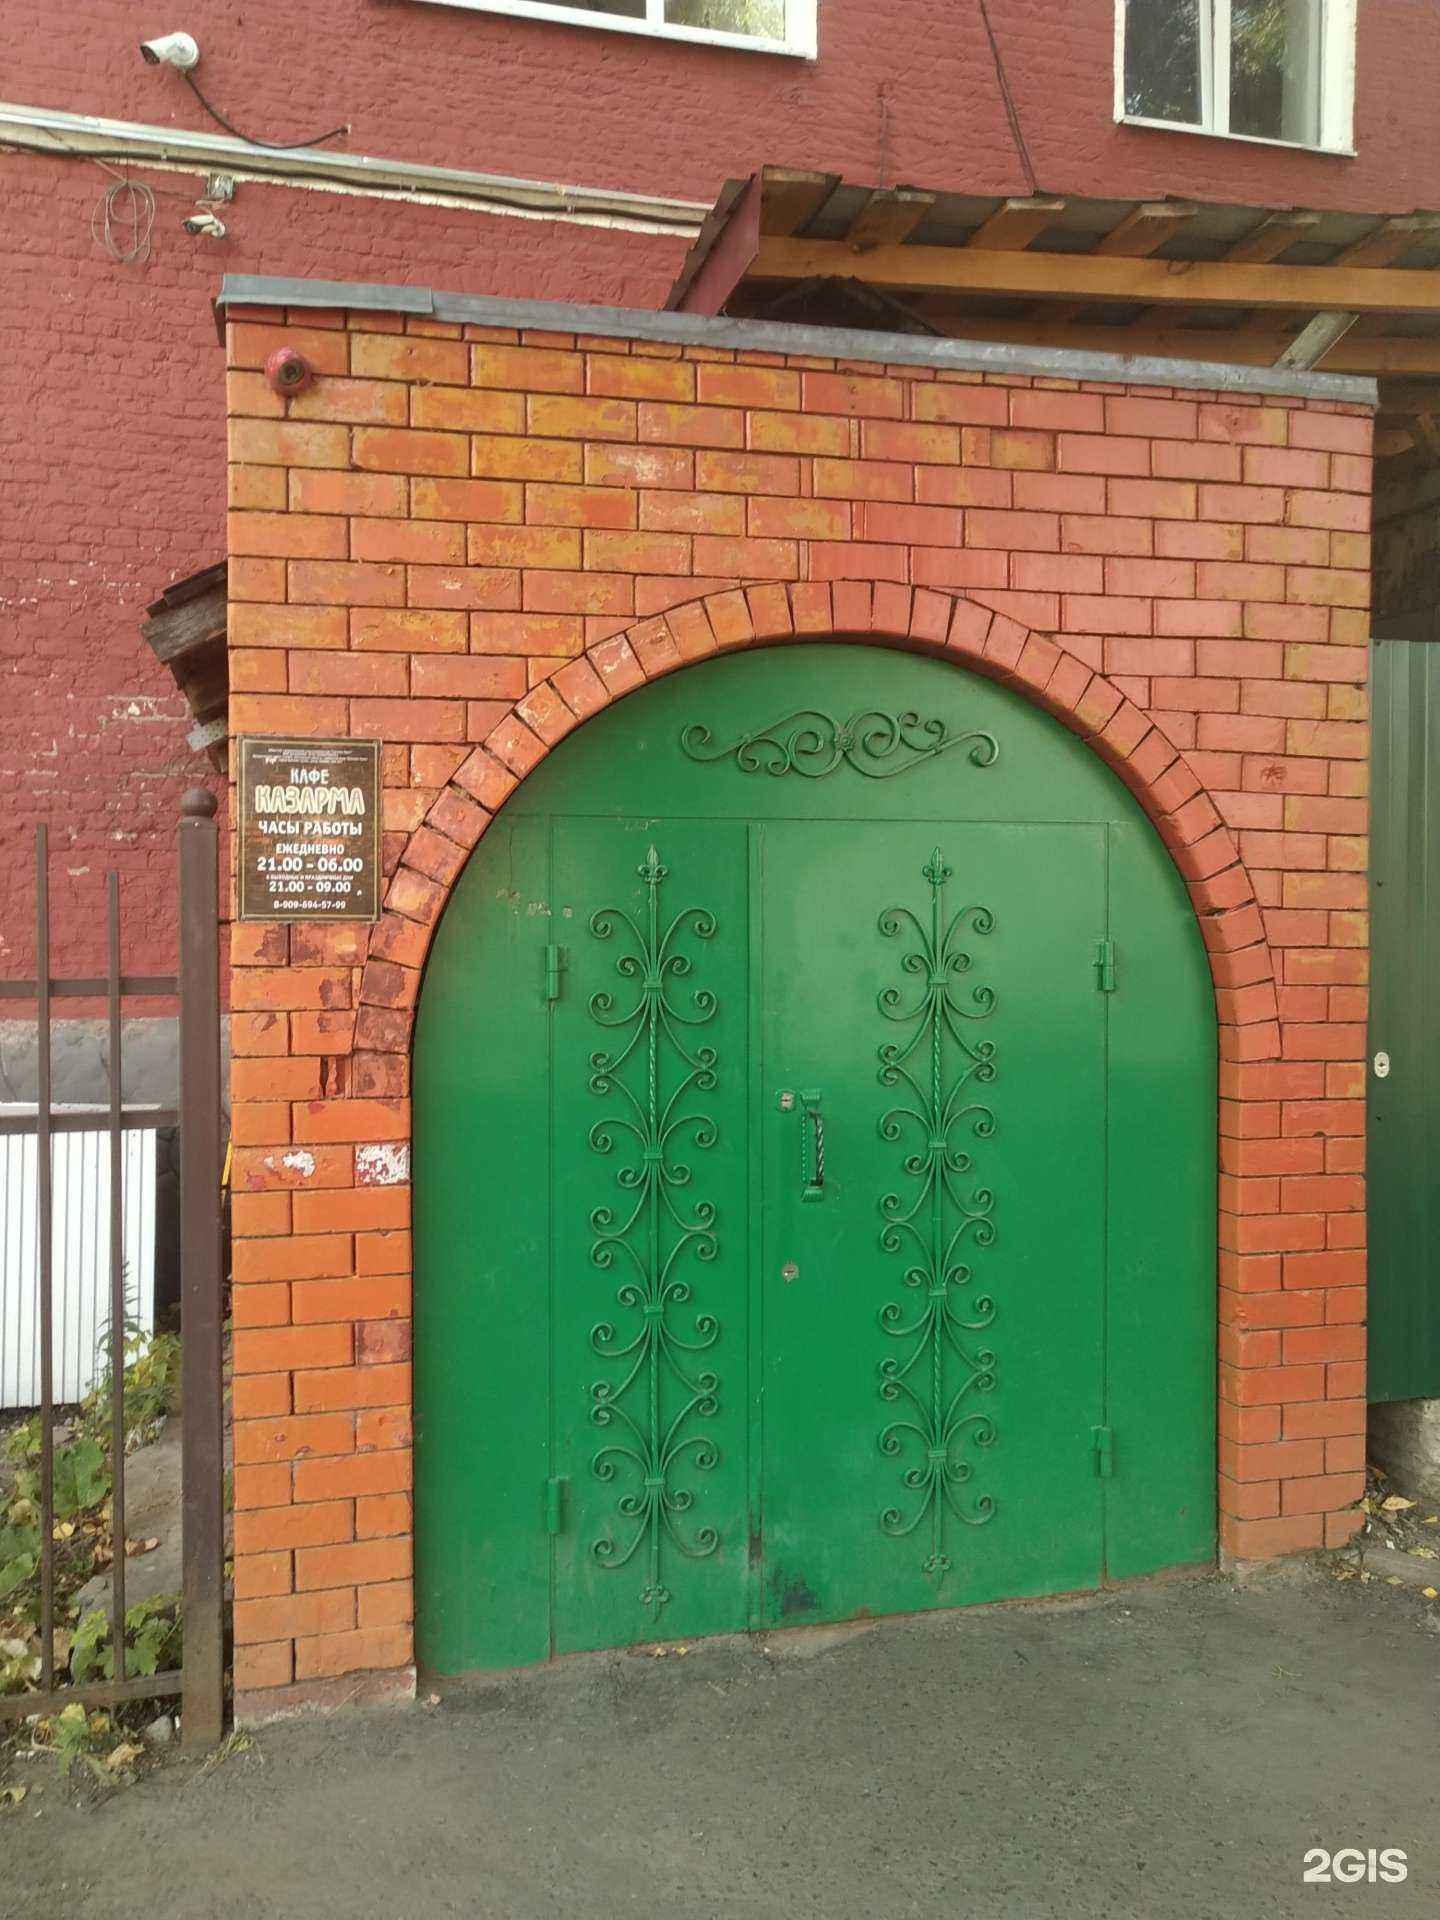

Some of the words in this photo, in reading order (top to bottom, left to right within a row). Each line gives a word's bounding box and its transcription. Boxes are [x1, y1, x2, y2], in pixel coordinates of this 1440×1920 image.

[290, 768, 329, 784] КАФЕ
[254, 784, 366, 815] КАЗАРМА
[258, 820, 300, 835] ЧАСЫ
[303, 820, 362, 836] РАБОТЫ
[275, 843, 344, 856] ЕЖЕДНЕВНО
[257, 857, 303, 871] 21.00
[317, 857, 364, 872] 06.00
[268, 881, 305, 893] 21.00
[315, 881, 351, 893] 09.00
